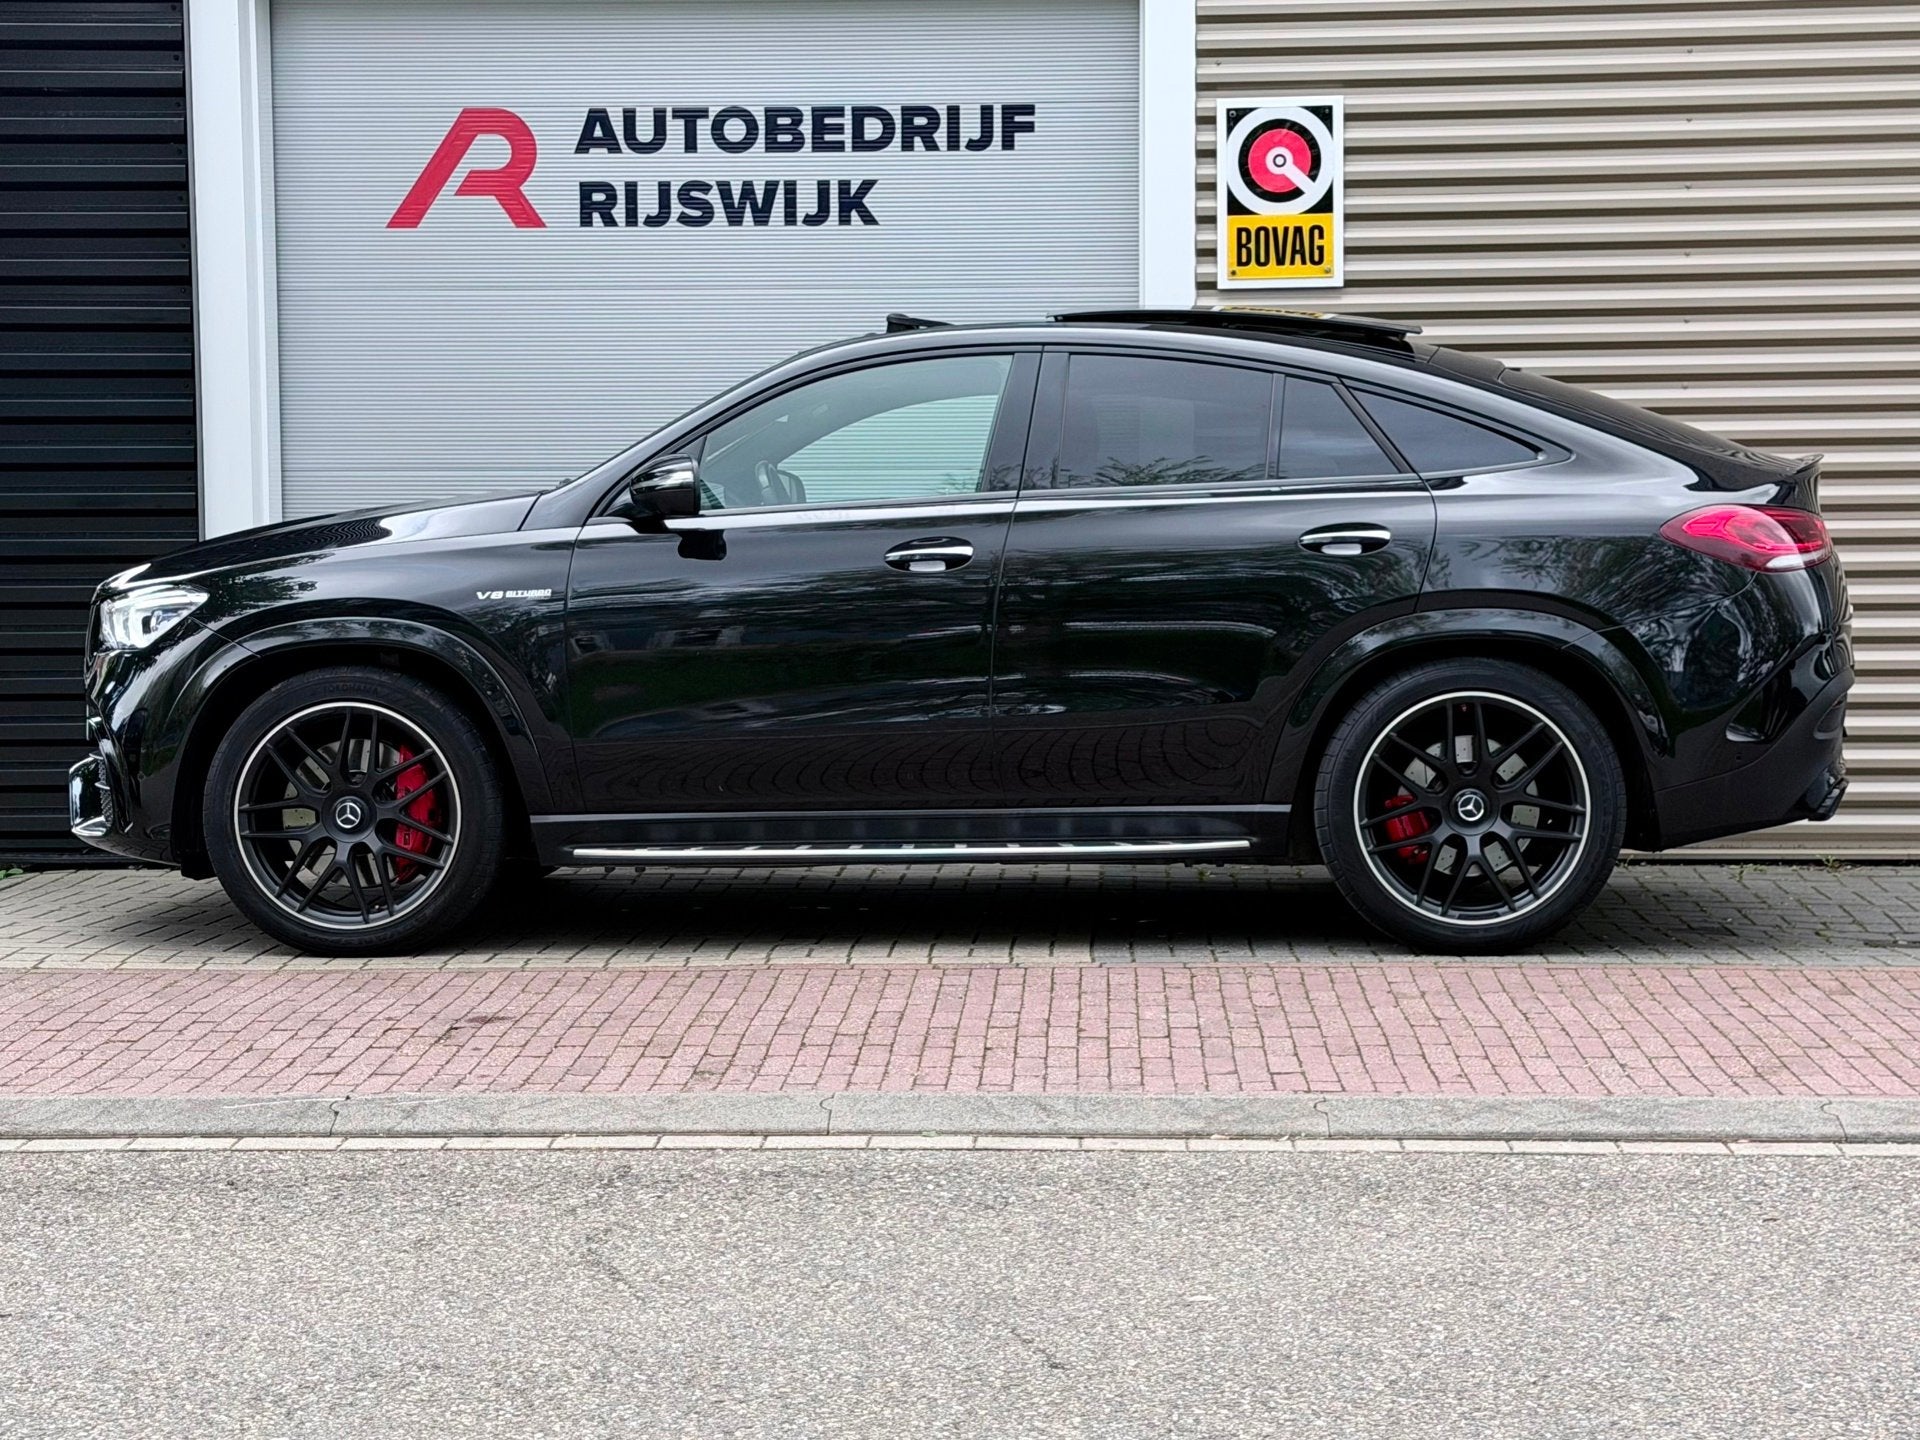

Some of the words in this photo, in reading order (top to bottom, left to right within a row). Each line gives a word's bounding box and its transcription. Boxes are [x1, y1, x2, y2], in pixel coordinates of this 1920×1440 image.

[574, 104, 1036, 155] AUTOBEDRIJF
[579, 179, 880, 228] RIJSWIJK
[1236, 224, 1325, 268] BOVAG
[476, 590, 504, 600] V8
